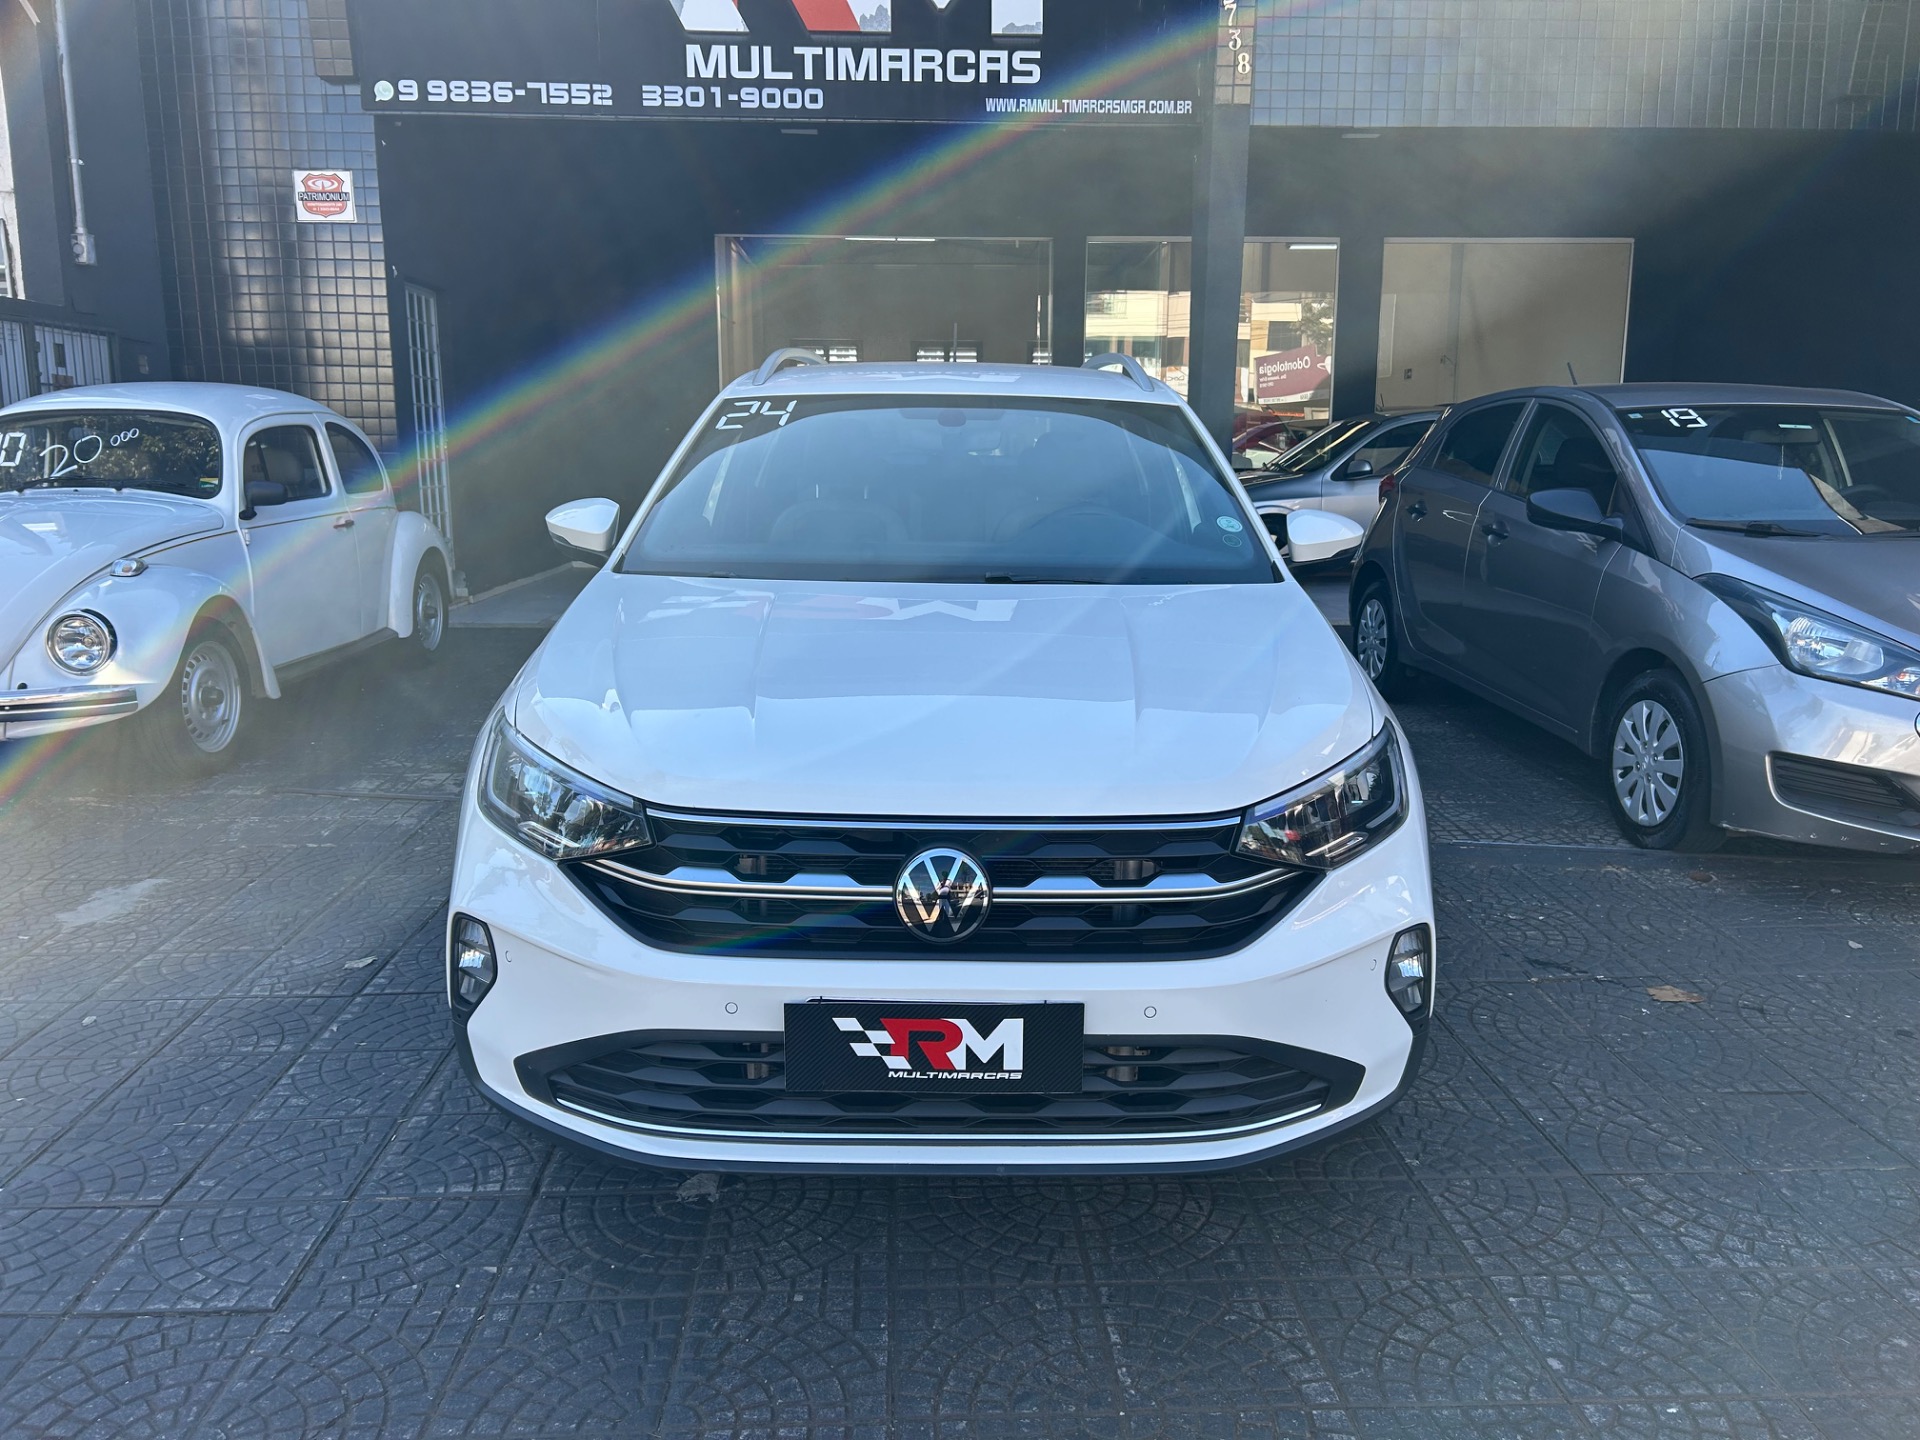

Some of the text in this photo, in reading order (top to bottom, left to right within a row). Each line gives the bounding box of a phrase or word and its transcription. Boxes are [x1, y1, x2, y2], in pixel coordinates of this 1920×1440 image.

[686, 44, 1041, 84] MULTIMARCAS
[397, 79, 825, 109] 9 9836-7552 3301-9000
[985, 98, 1193, 114] WWW.RMMULTIMARCASMGA.COM.BR
[298, 192, 349, 201] PATRIMONIUM
[715, 400, 798, 430] 24
[1661, 408, 1708, 428] 19
[880, 1018, 1024, 1070] RM
[888, 1071, 1023, 1080] MULTIMARCAS
